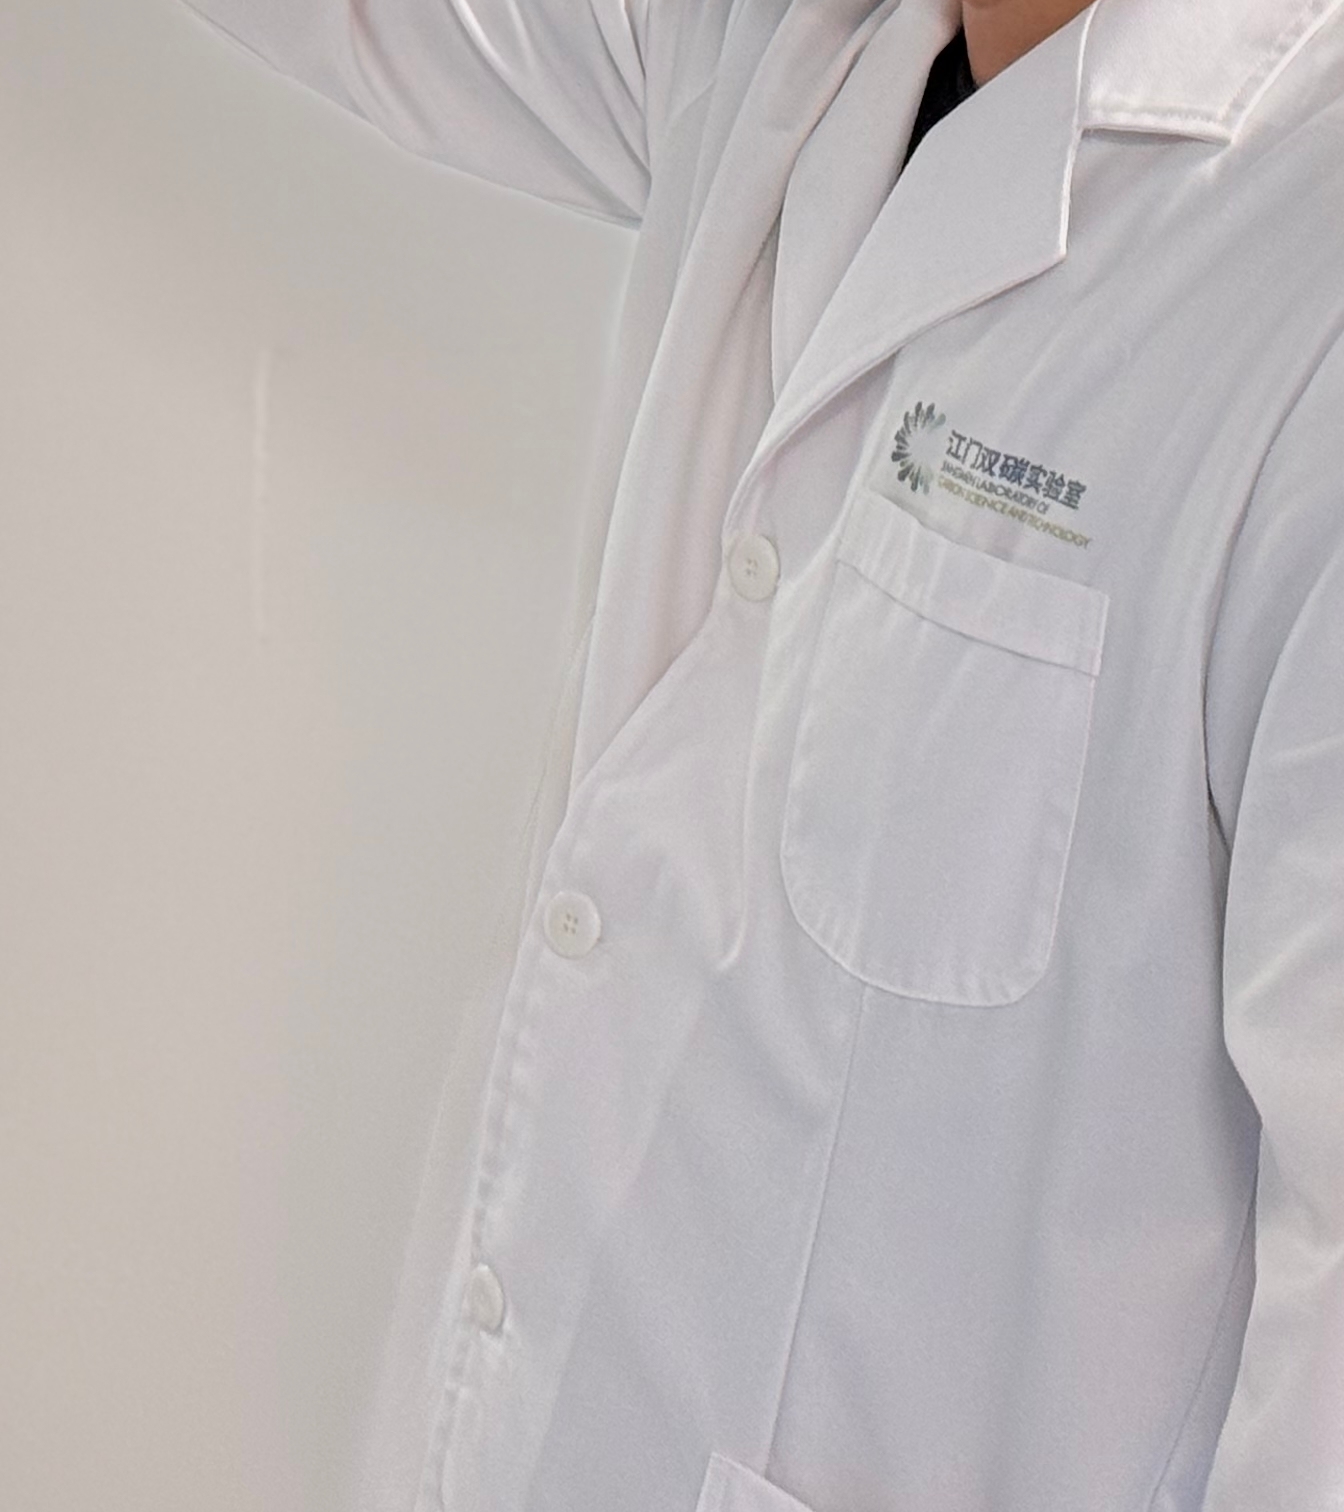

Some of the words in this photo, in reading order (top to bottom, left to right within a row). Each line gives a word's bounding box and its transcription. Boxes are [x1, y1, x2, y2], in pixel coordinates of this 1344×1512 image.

[946, 430, 1087, 510] 江门双碳实验室
